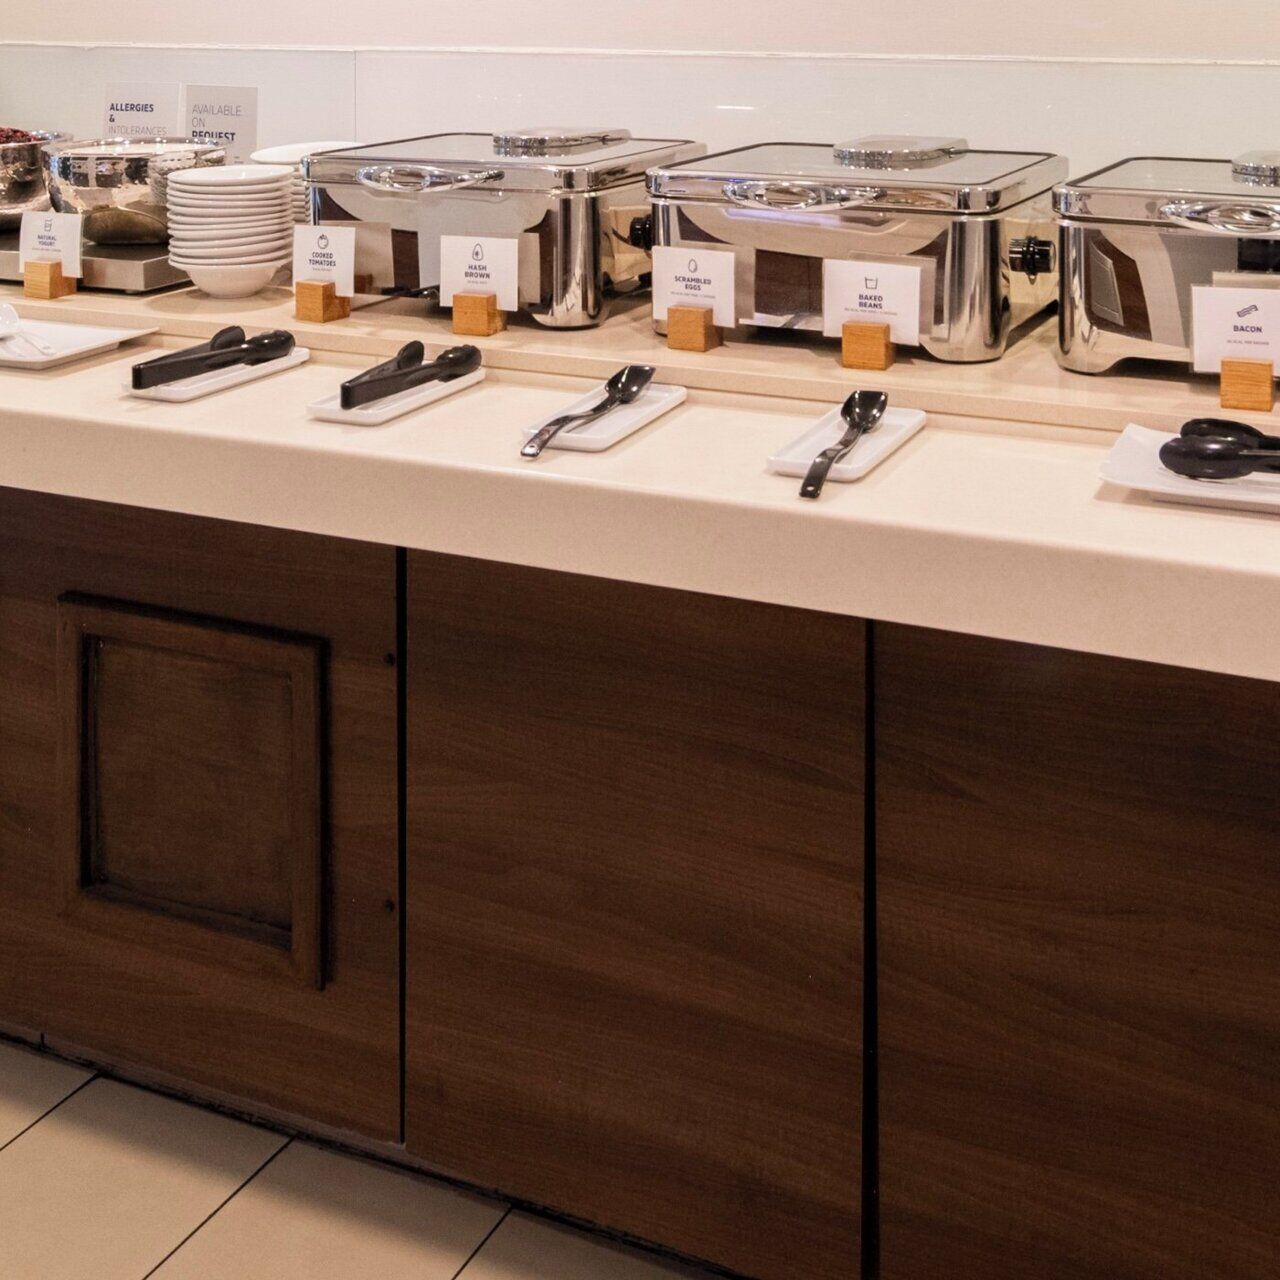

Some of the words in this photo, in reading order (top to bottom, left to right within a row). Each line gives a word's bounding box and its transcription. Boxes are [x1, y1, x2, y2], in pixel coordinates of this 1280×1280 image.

[109, 103, 154, 113] ALLERGIES
[192, 103, 242, 116] AVAILABLE
[108, 114, 116, 123] &
[192, 116, 206, 128] ON
[108, 125, 167, 136] INTOLERANCES
[312, 251, 334, 259] COOKED
[308, 259, 337, 267] TOMATOES
[464, 271, 490, 279] BROWN
[674, 275, 712, 285] SCRAMBLED
[858, 293, 883, 302] BAKED
[858, 301, 883, 310] BEANS
[1233, 324, 1263, 333] BACON
